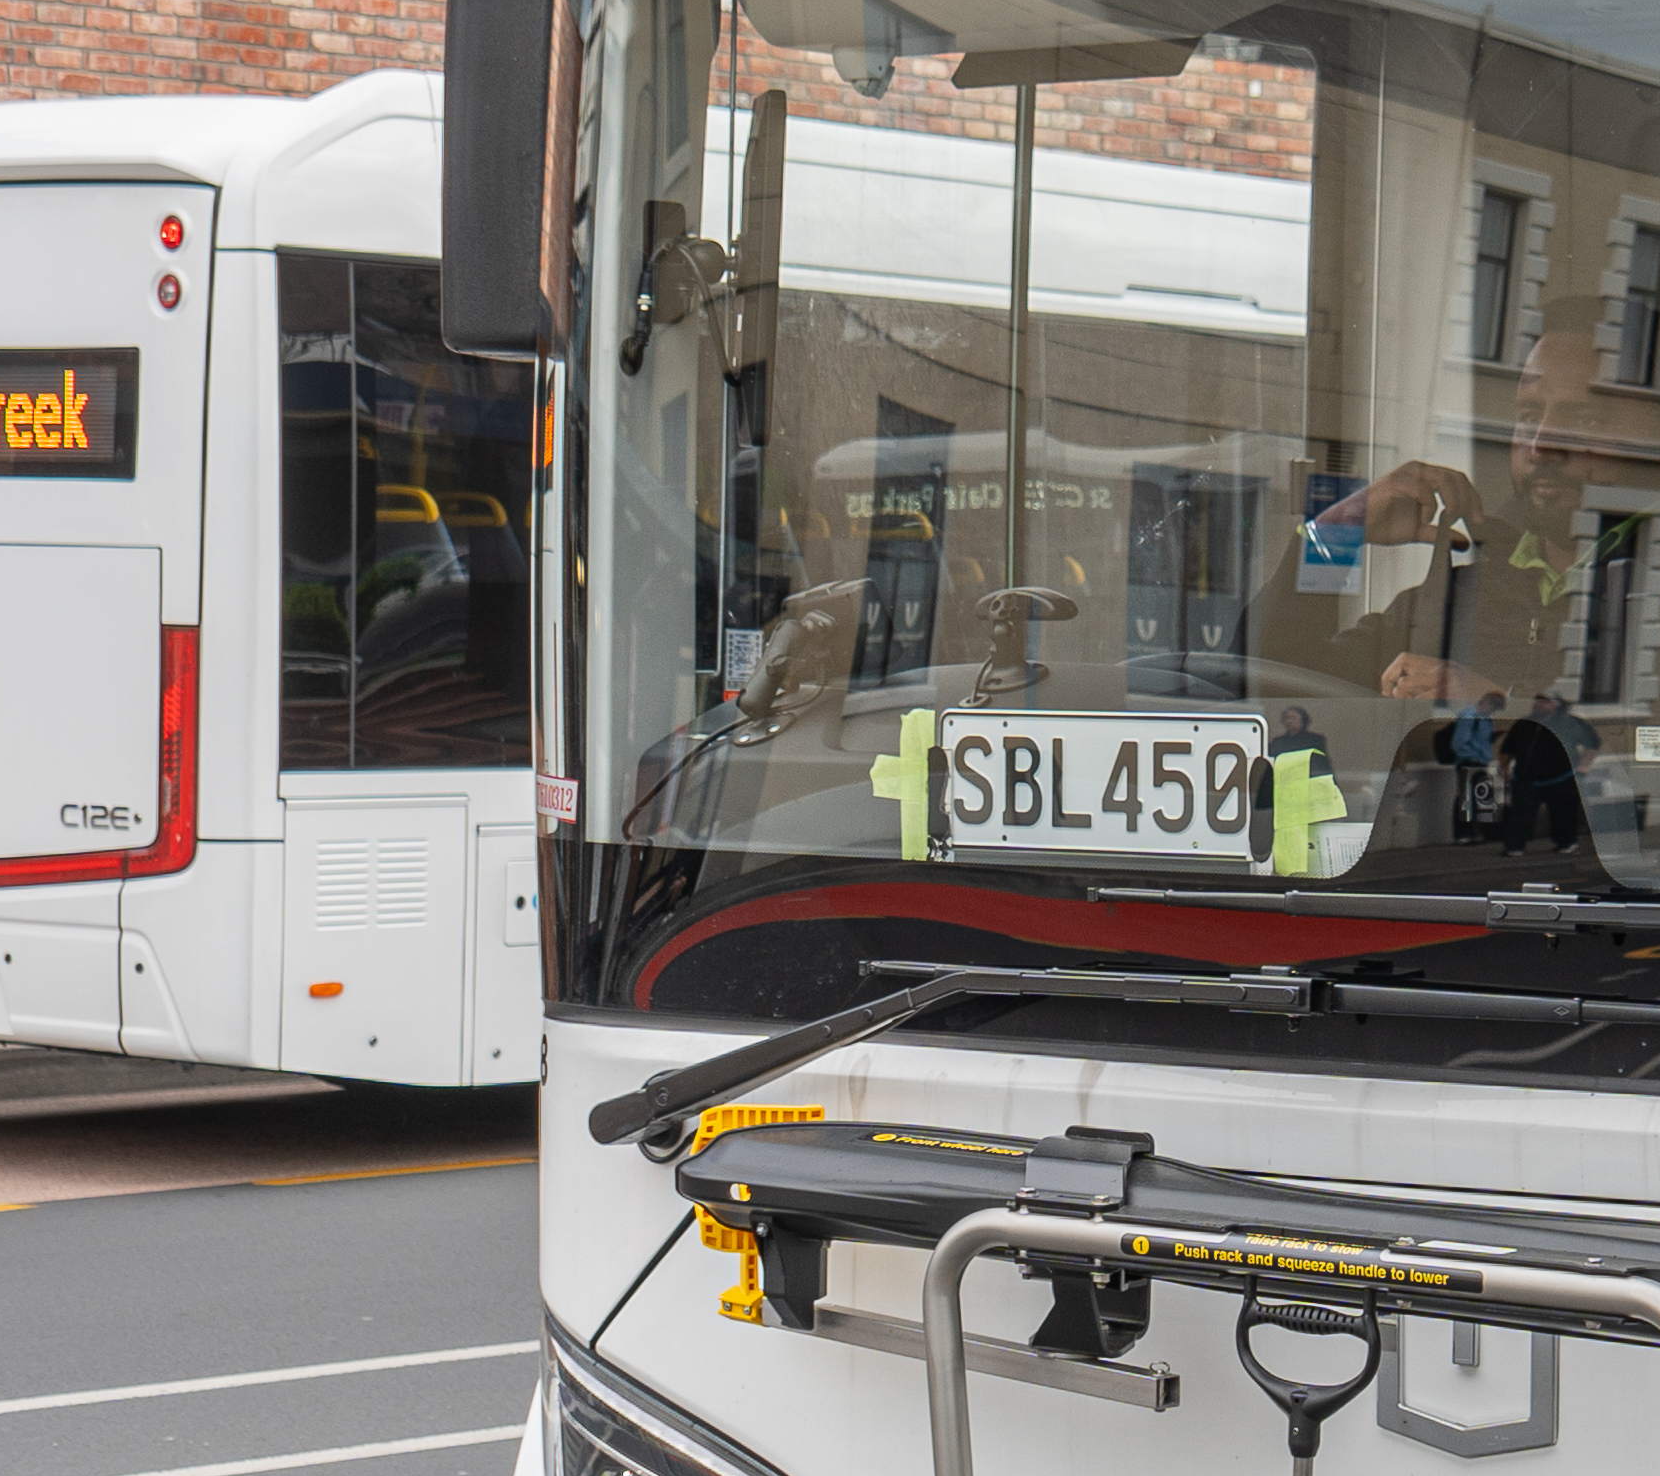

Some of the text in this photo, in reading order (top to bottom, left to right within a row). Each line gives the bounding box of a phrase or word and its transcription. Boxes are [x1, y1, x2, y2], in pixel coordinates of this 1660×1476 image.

[951, 734, 1251, 836] SBL450
[60, 803, 130, 831] C12E
[895, 1136, 940, 1146] Front
[940, 1142, 985, 1152] wheel
[986, 1147, 1024, 1156] here
[1312, 1241, 1327, 1252] to
[1329, 1242, 1364, 1256] stow
[1175, 1242, 1209, 1260] Push
[1213, 1248, 1243, 1263] rack
[1247, 1252, 1273, 1267] and
[1277, 1256, 1335, 1274] squeeze
[1339, 1262, 1387, 1279] handle
[1391, 1266, 1405, 1281] to
[1409, 1268, 1449, 1286] lower
